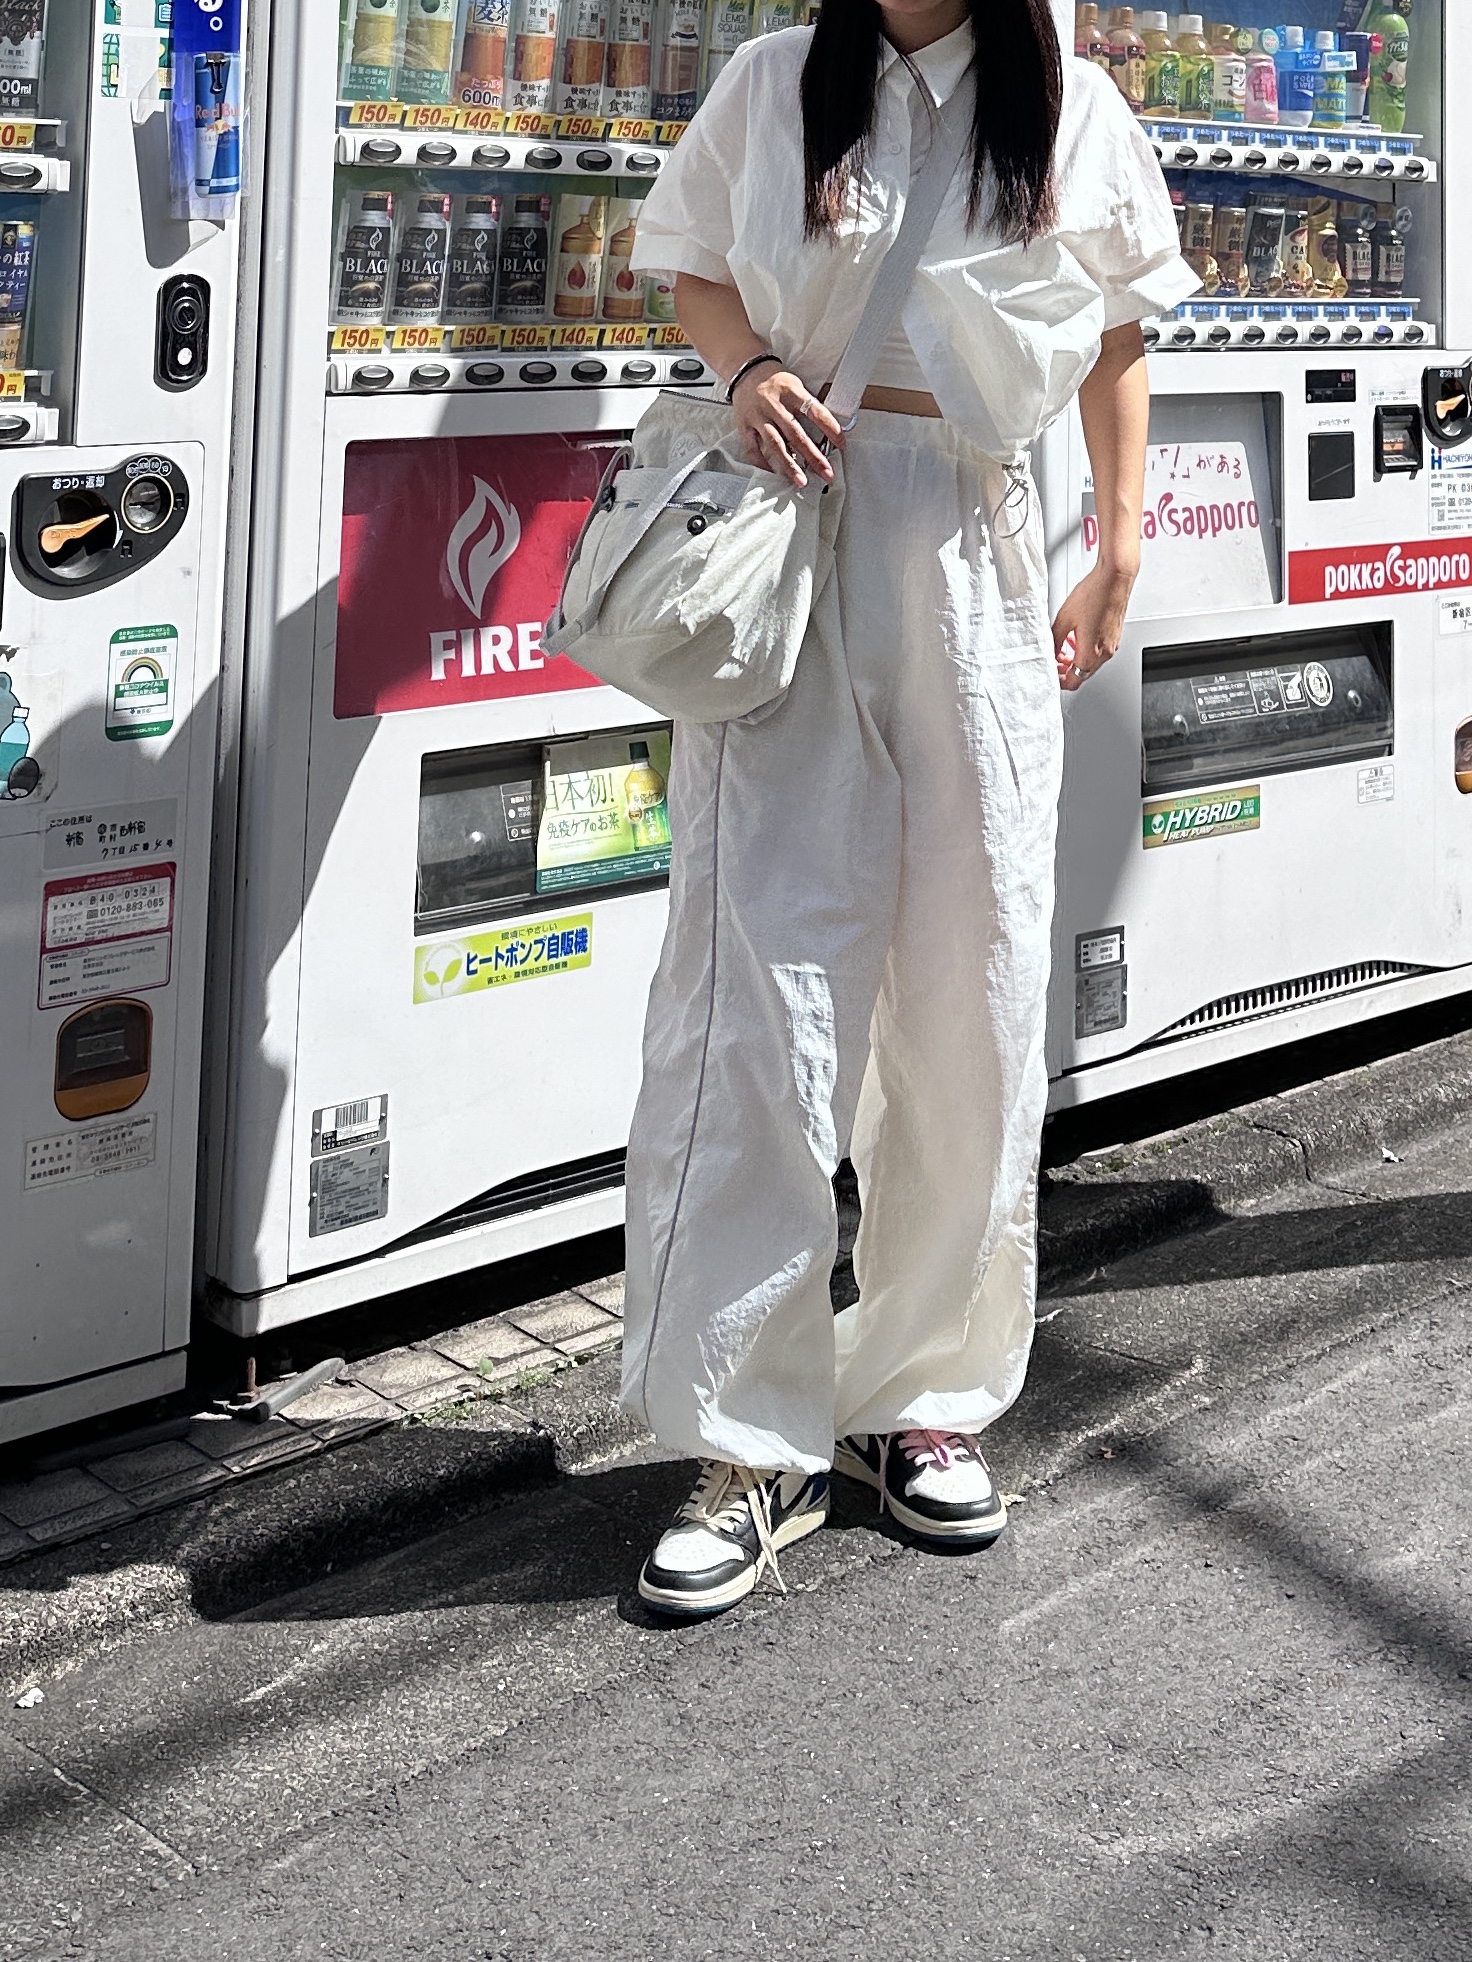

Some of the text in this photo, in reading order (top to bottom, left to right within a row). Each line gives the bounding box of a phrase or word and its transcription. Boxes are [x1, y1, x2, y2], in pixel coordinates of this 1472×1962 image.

[222, 102, 240, 118] Bul
[462, 88, 499, 106] 600m
[661, 326, 688, 344] 150
[1167, 501, 1260, 540] sapporo
[429, 621, 545, 681] FIRE
[547, 811, 620, 840] 免疫ケアのお茶
[1163, 800, 1241, 841] HYBRID
[466, 927, 588, 977] ヒートポンプ自販機
